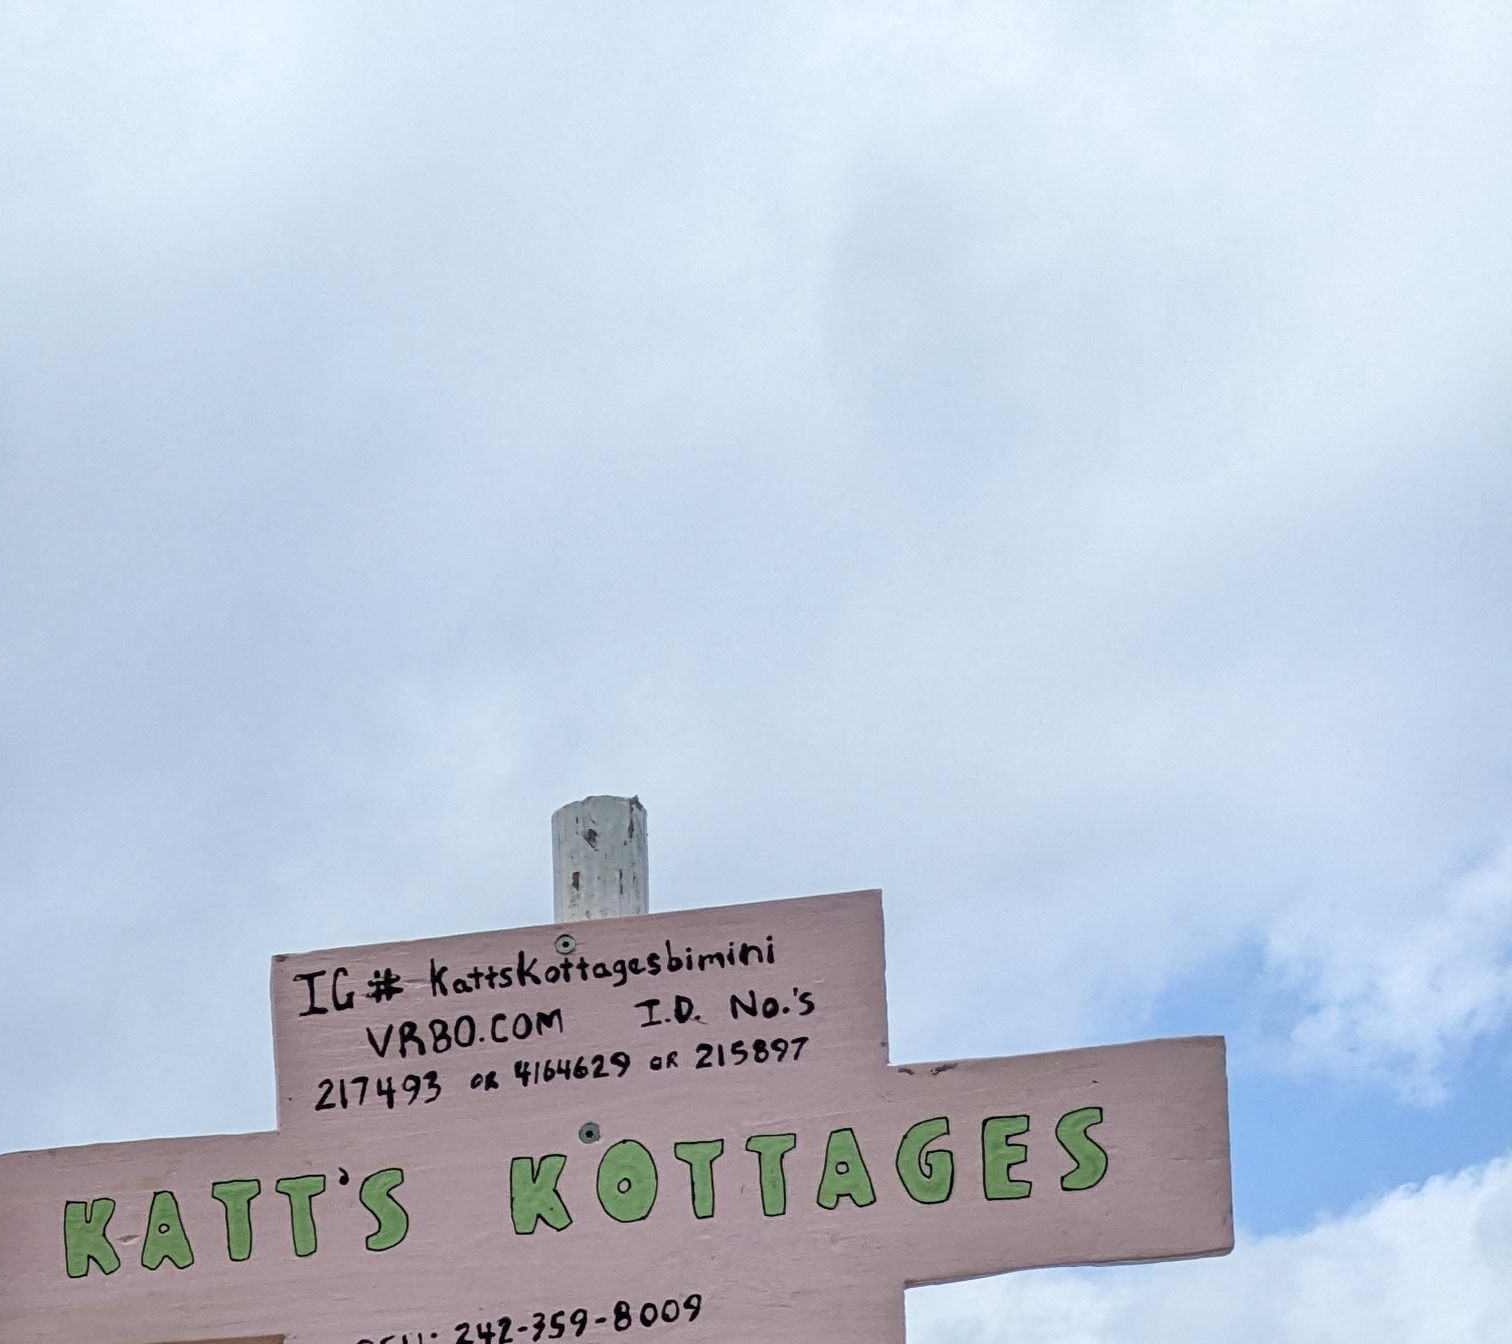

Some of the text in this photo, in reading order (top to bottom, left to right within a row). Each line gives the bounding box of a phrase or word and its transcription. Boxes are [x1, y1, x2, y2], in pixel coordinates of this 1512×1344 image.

[365, 1008, 563, 1058] VRBO.COM
[314, 1070, 442, 1112] 217493
[514, 1051, 631, 1087] 4164629
[695, 1036, 809, 1070] 215897
[63, 1106, 1109, 1279] KATT'S KOTTAGES
